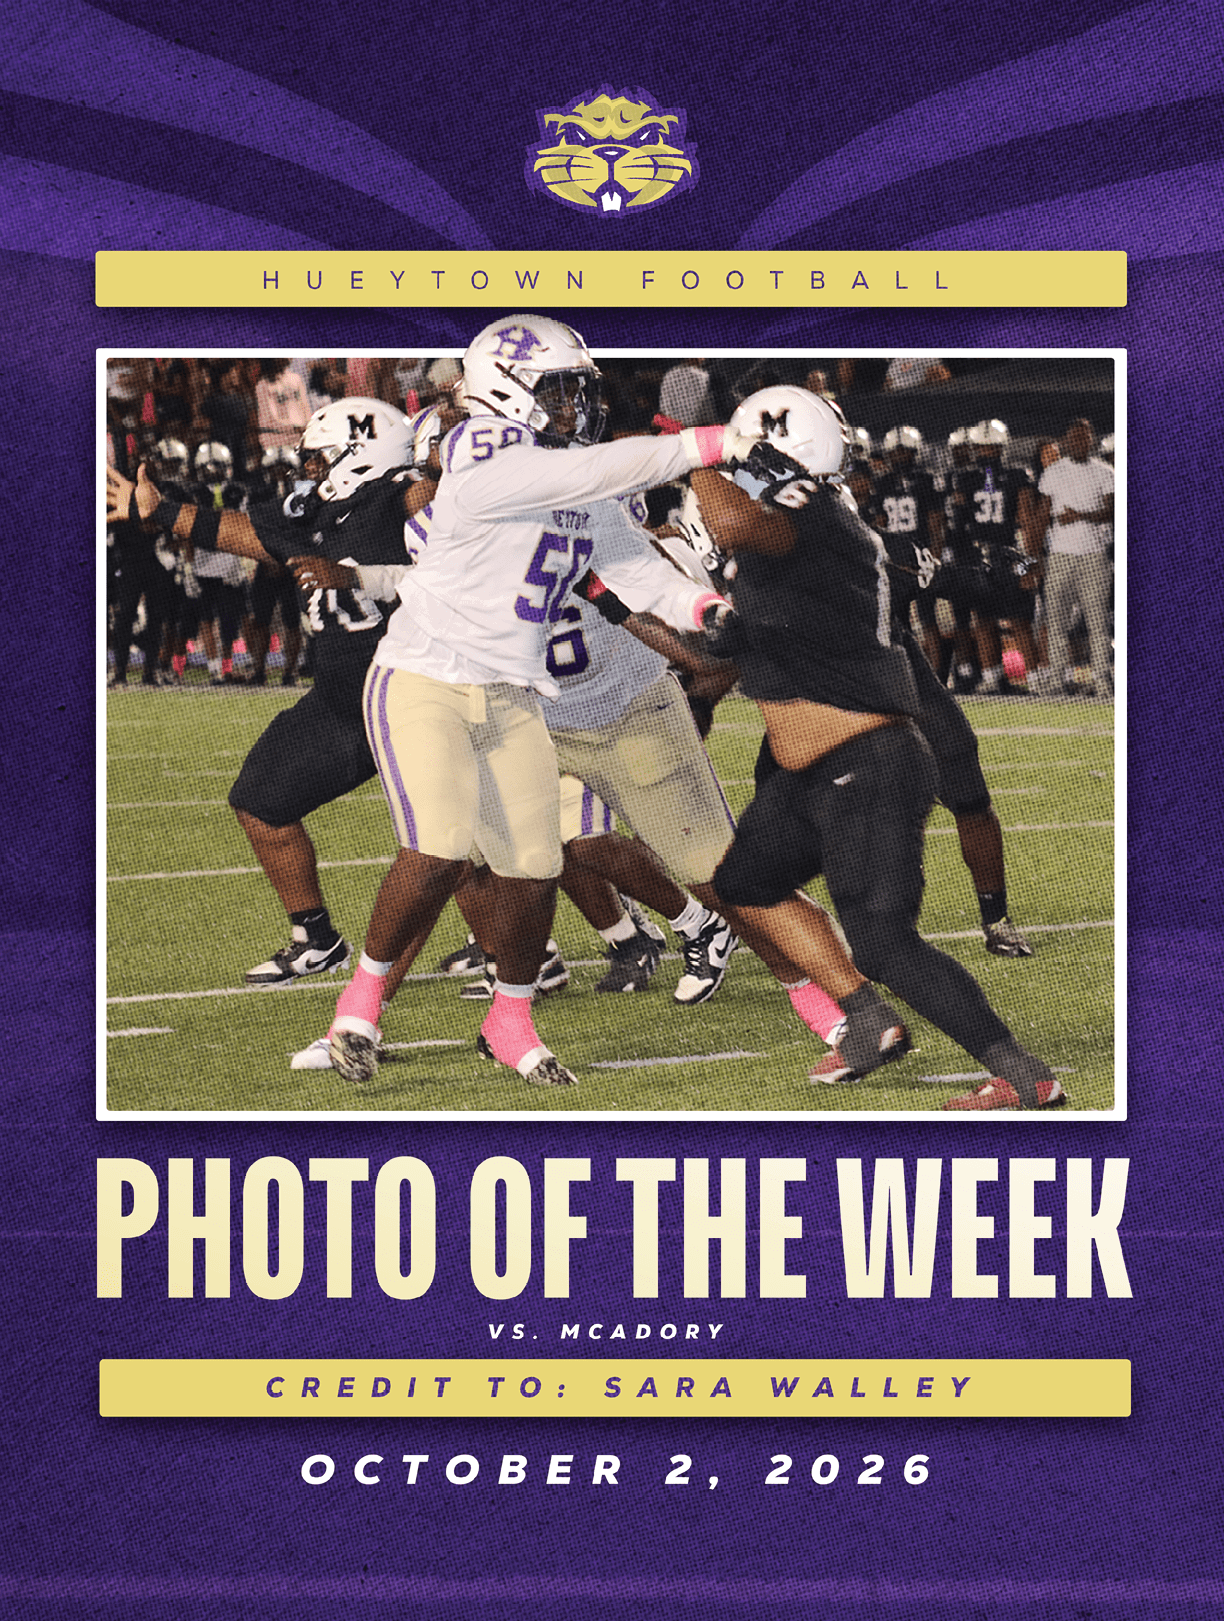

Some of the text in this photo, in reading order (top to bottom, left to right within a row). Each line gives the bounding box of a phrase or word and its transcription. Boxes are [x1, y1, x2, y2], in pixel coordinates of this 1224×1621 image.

[347, 413, 378, 440] M
[759, 410, 790, 440] M
[973, 490, 1004, 524] 31
